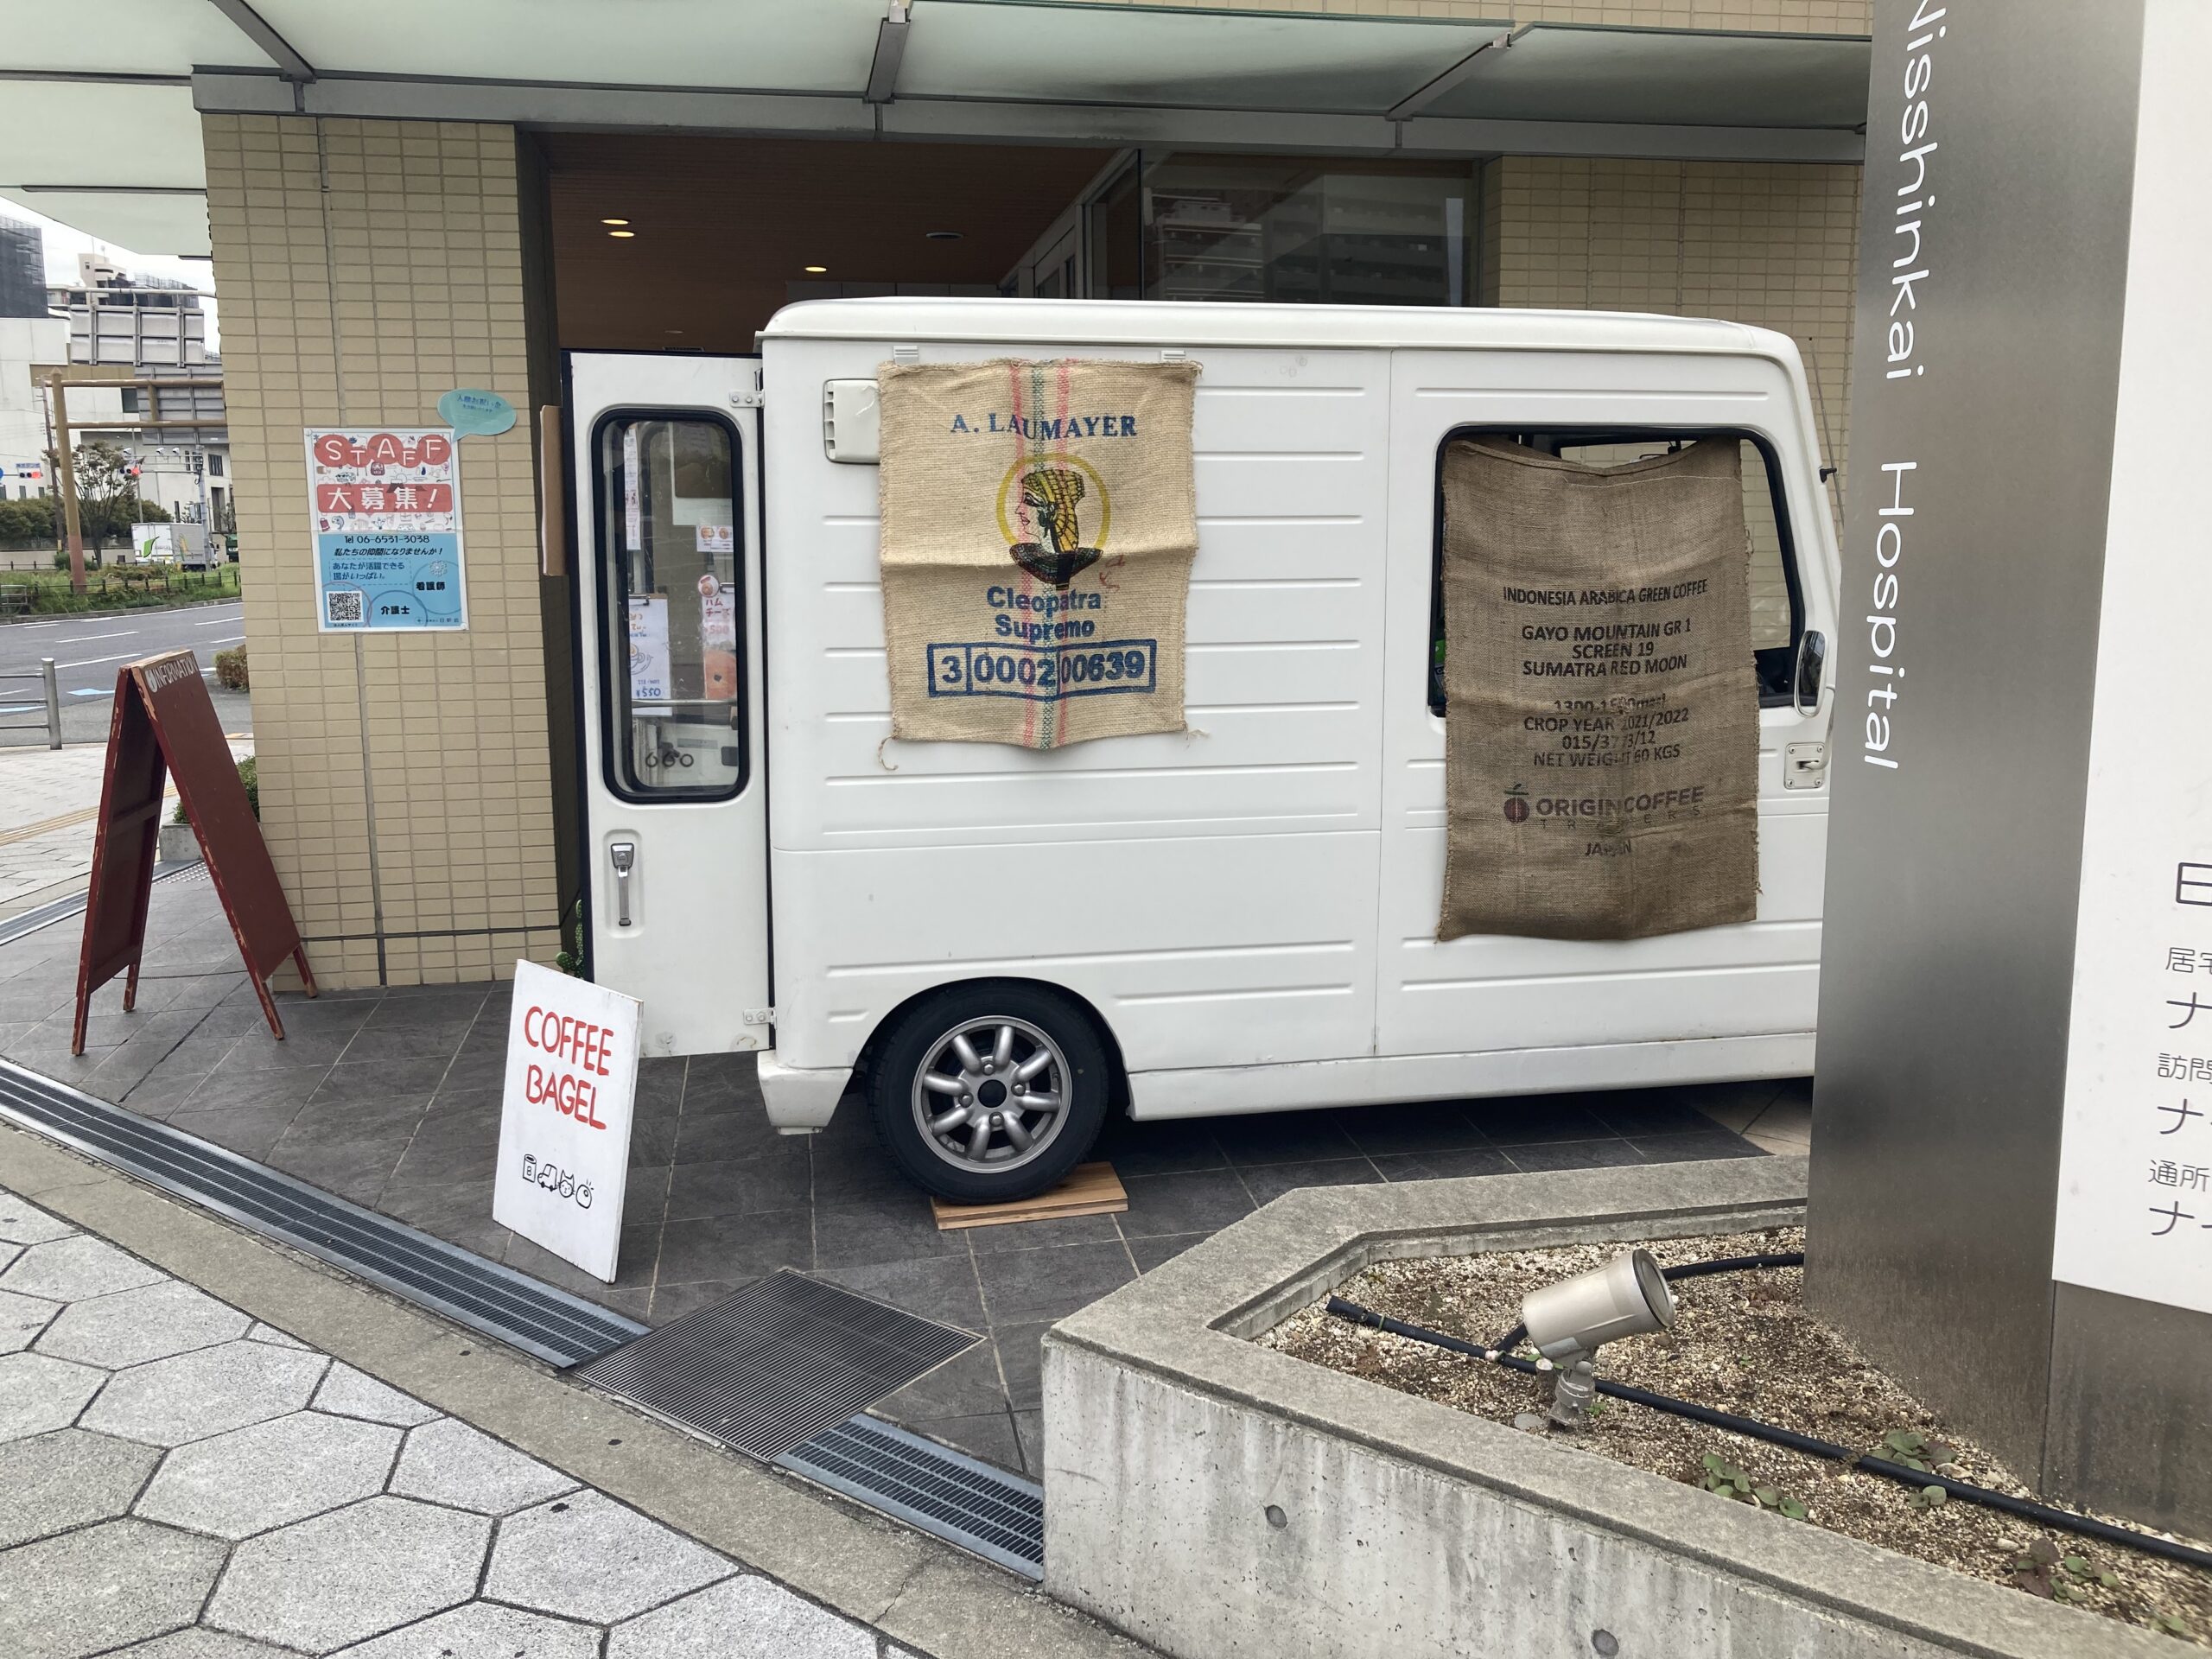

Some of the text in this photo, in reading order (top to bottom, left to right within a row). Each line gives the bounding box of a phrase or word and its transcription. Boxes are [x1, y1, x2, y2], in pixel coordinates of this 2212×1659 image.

[950, 413, 1137, 441] A. LAUMAYER
[324, 438, 442, 466] STAFF
[344, 535, 430, 544] Tel 06-6531-3038
[416, 582, 446, 591] 看護師
[1503, 579, 1708, 605] INDONESIA ARABICA GREEN COFFEE
[380, 605, 410, 615] 介護士
[987, 586, 1101, 617] Cleopatra
[1864, 461, 1917, 769] Hospital
[995, 614, 1095, 643] Supremo
[1522, 618, 1691, 642] GAYO MOUNTAIN GR 1
[1573, 641, 1654, 659] SCREEN 19
[153, 654, 199, 689] INFORMATION
[942, 657, 963, 683] 3
[1522, 654, 1688, 677] SUMATRA RED MOON
[1523, 708, 1689, 733] CROP YEAR 2021/2022
[1534, 753, 1565, 766] NET
[1654, 744, 1681, 760] KGS
[1585, 839, 1632, 857] JAN
[524, 1006, 613, 1076] COFFEE
[525, 1064, 607, 1129] BAGEL
[2148, 1160, 2210, 1192] 通所
